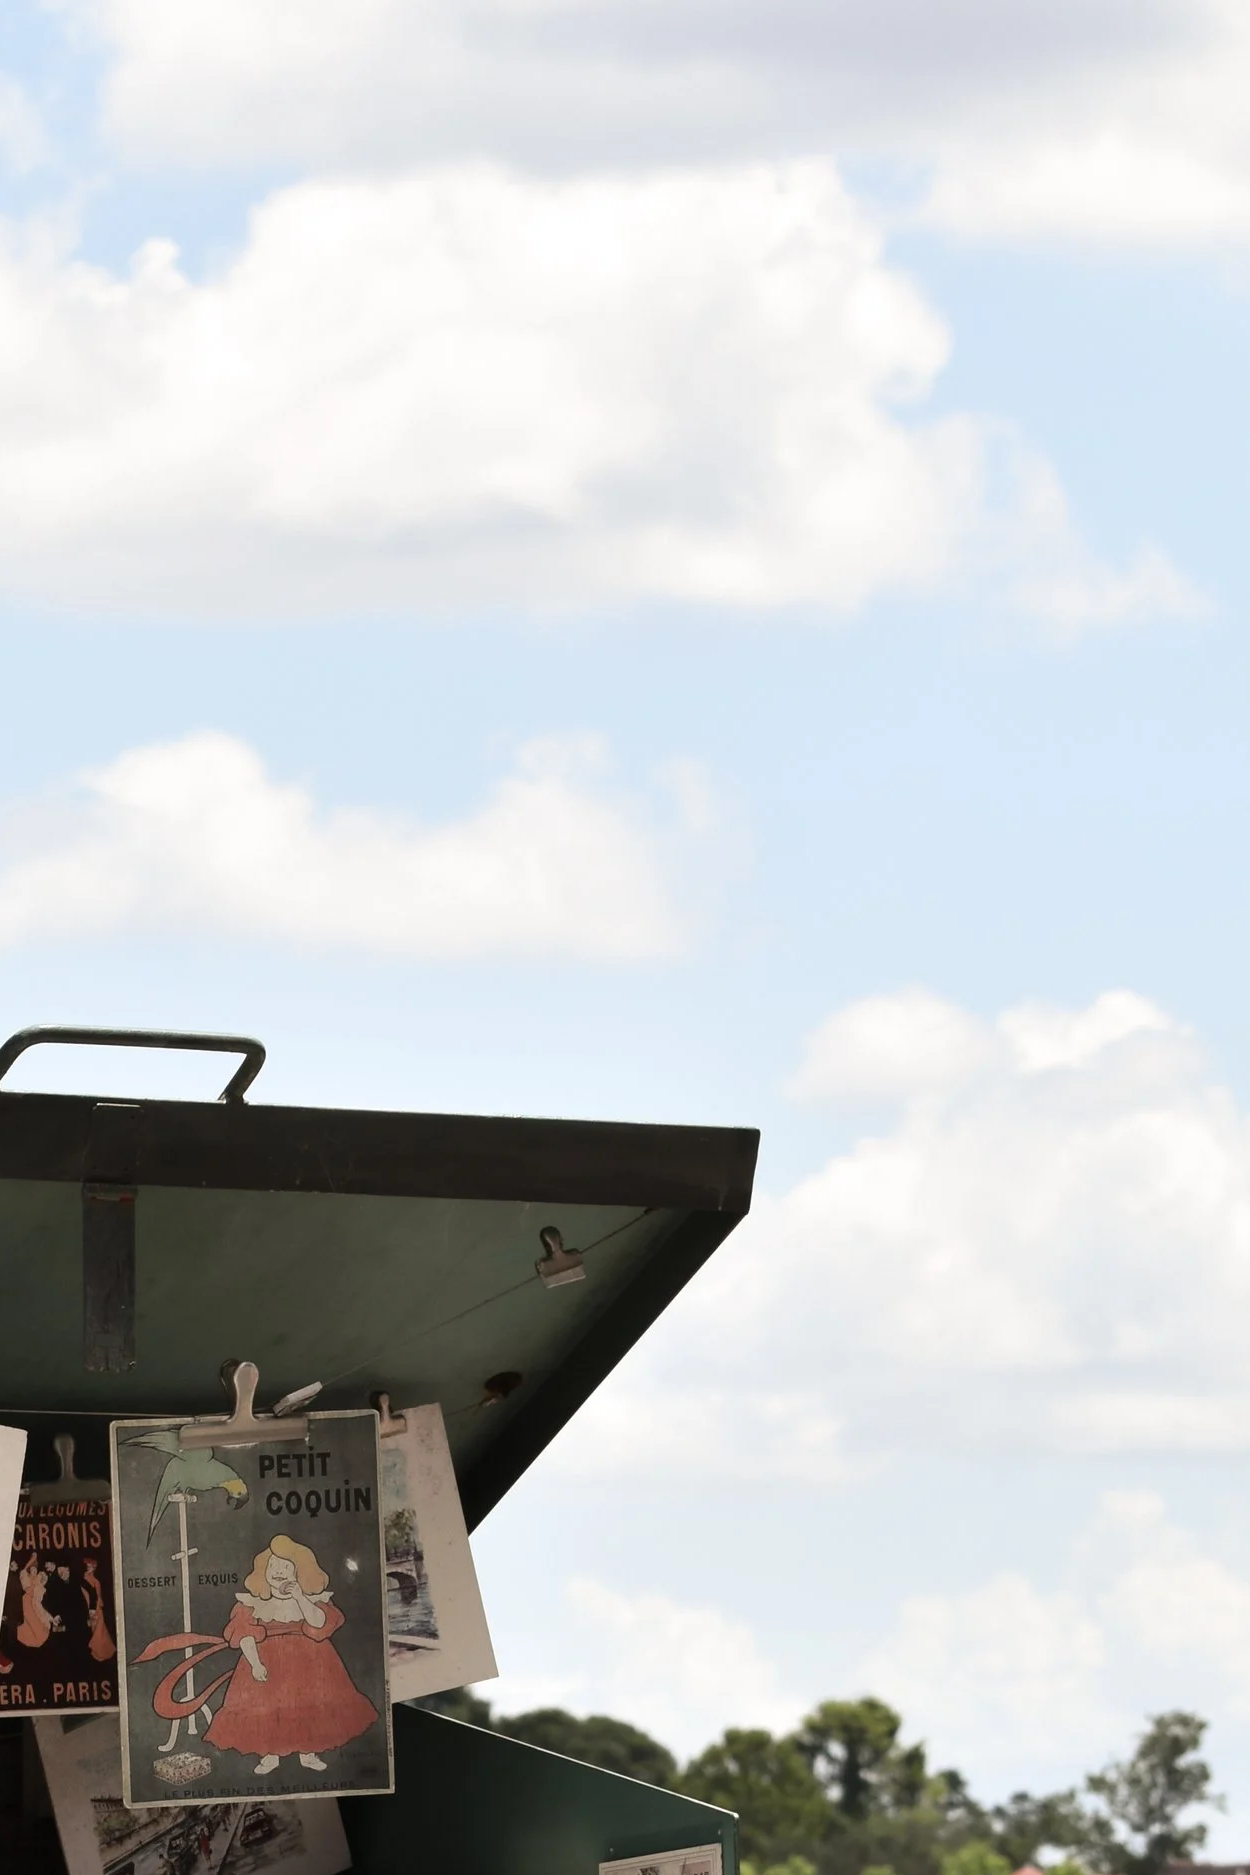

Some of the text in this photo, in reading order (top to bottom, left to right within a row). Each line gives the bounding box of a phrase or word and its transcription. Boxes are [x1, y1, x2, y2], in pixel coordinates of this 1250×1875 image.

[127, 1573, 239, 1589] DESSERT EXQUIS
[53, 1680, 112, 1703] PARIS
[164, 1790, 178, 1799] LE
[184, 1788, 215, 1798] PLUS
[220, 1787, 240, 1796] FIN
[246, 1785, 274, 1795] DES
